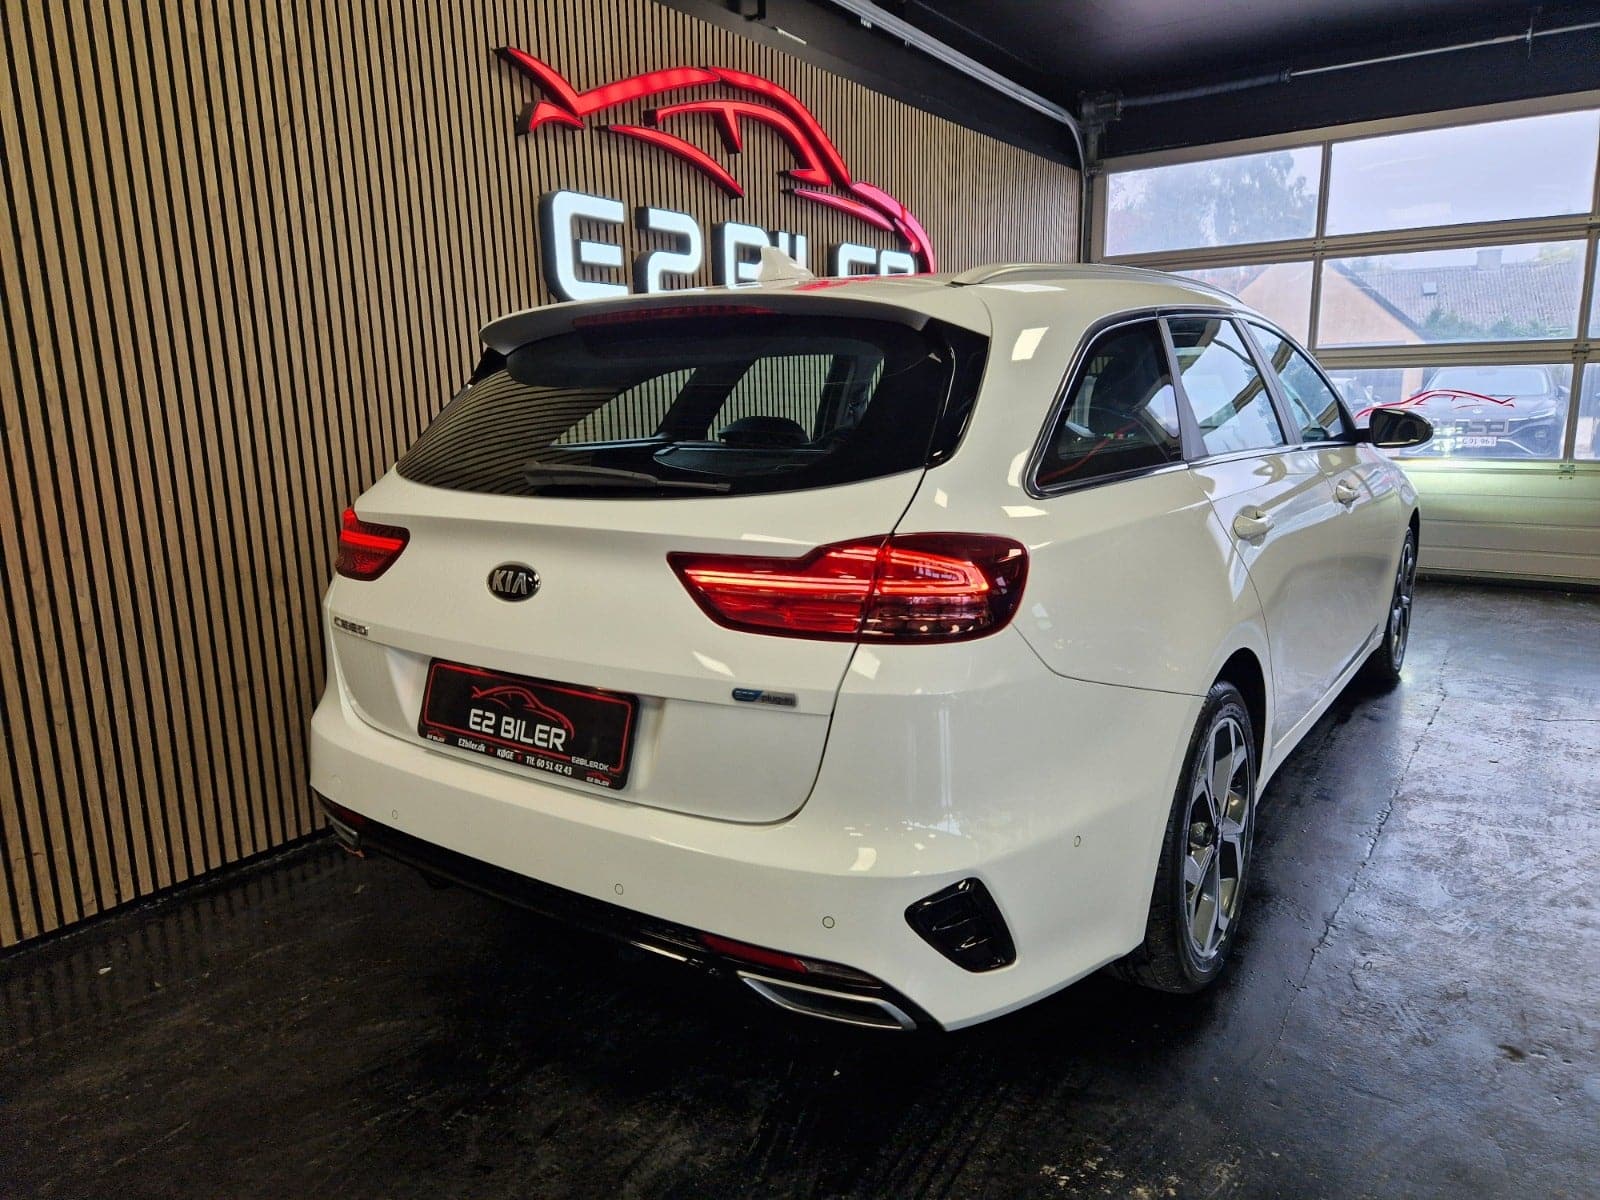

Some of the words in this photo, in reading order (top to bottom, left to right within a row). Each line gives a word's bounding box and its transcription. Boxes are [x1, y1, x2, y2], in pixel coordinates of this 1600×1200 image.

[547, 190, 703, 301] E2
[492, 569, 527, 595] KIA
[469, 708, 496, 735] E2
[500, 716, 567, 752] BILER
[457, 738, 486, 752] E2biler.dk
[497, 748, 514, 760] KØGE
[536, 758, 545, 769] 60
[545, 761, 554, 771] 51
[554, 763, 563, 773] 42
[563, 766, 573, 776] 43
